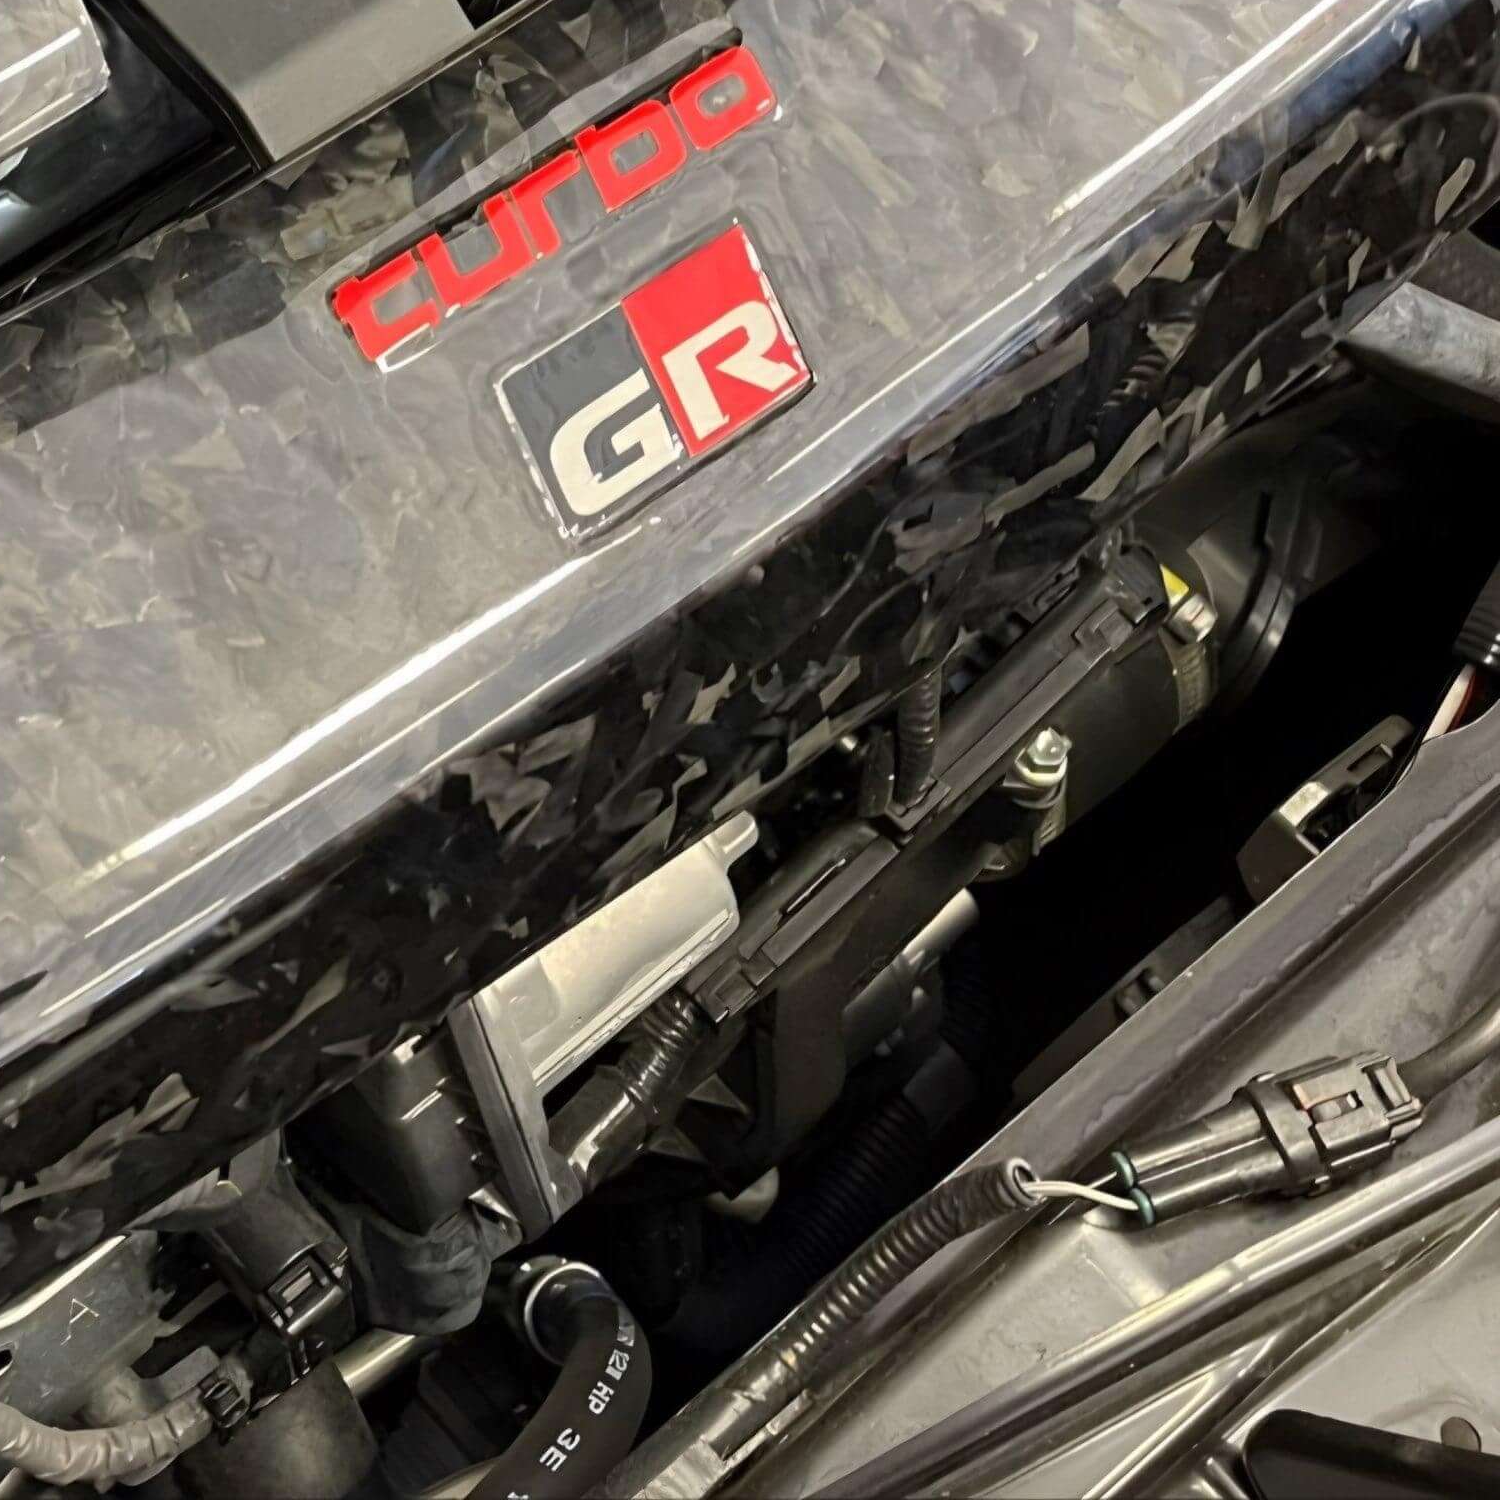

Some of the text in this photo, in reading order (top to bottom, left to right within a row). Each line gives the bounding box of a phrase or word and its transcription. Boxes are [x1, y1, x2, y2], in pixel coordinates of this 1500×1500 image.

[549, 300, 798, 516] GR
[588, 1381, 615, 1415] HP
[539, 1427, 581, 1472] 3E
